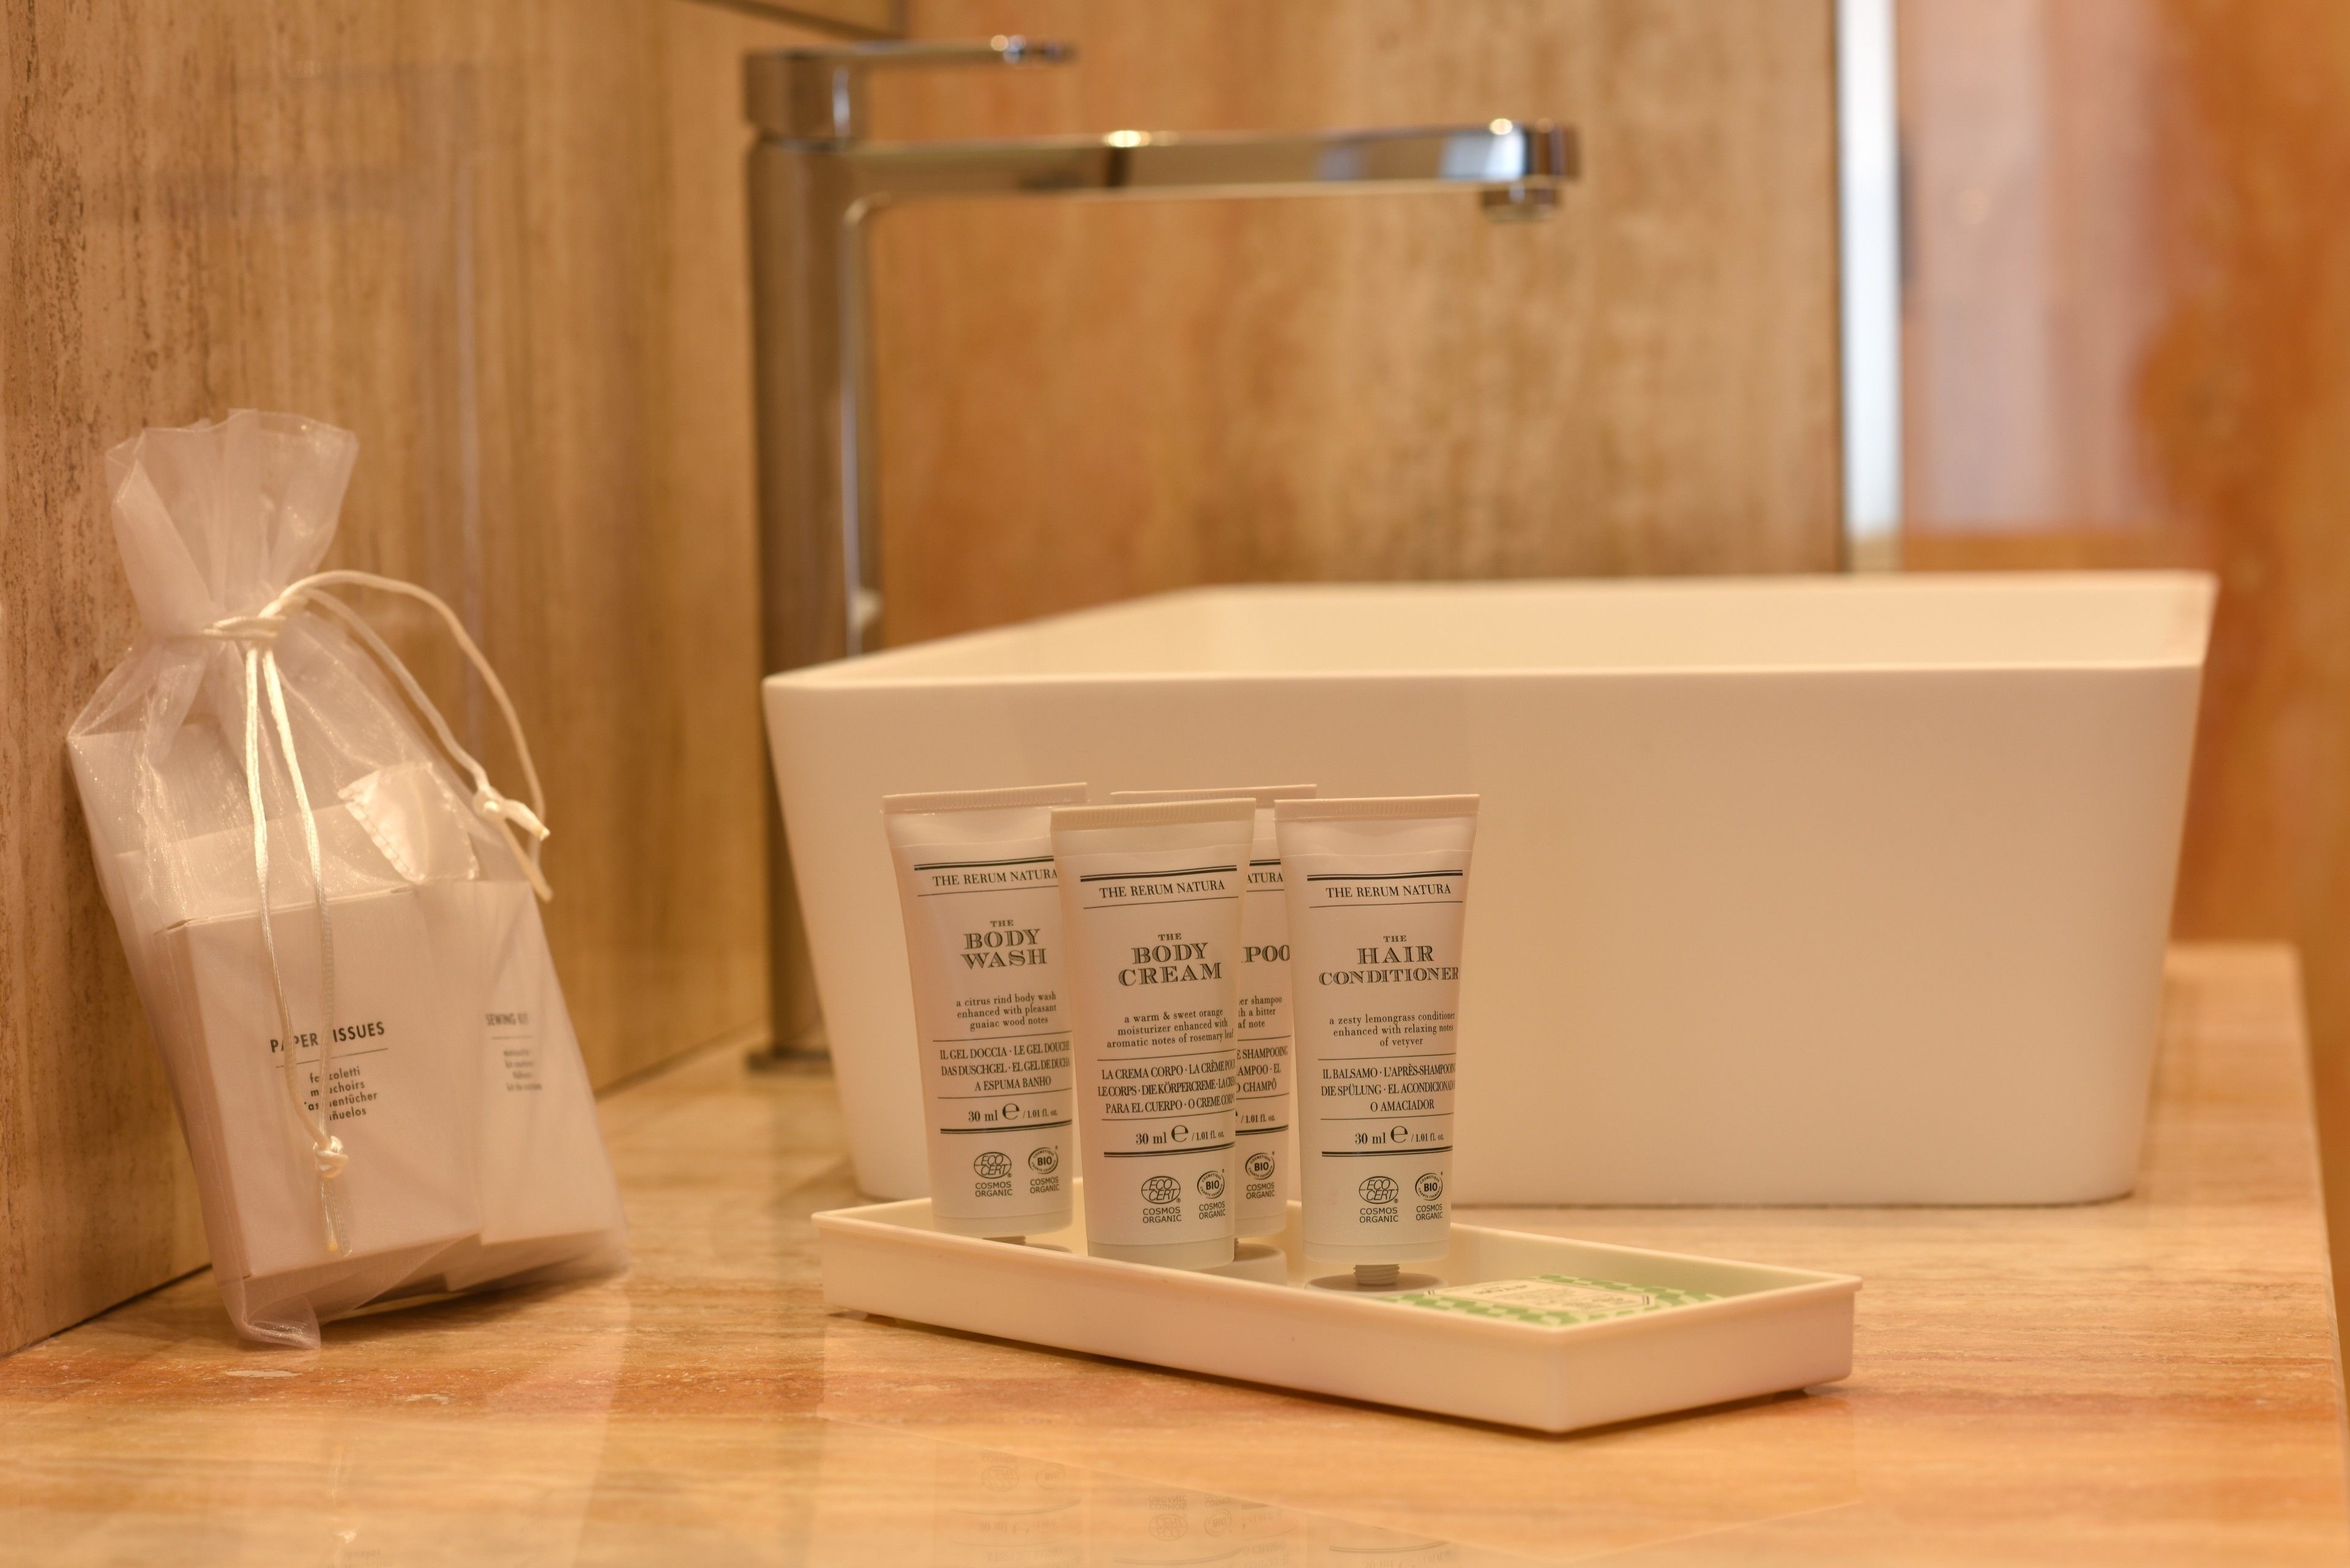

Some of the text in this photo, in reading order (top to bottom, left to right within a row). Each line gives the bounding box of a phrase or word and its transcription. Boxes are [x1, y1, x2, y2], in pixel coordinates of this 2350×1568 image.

[933, 869, 1058, 886] THE RERUM NATURA
[1247, 872, 1283, 884] ATURA
[1099, 880, 1225, 898] THE RERUM NATURA
[1326, 884, 1451, 898] THE RERUM NATURA
[963, 929, 1040, 949] BODY
[961, 949, 1047, 969] WASH
[1132, 943, 1209, 964] BODY
[1357, 946, 1434, 965] HAIR
[1119, 962, 1222, 987] CREAM
[1319, 966, 1459, 985] CONDITIONER
[965, 997, 990, 1006] citrus
[994, 993, 1012, 1004] rind
[1015, 993, 1035, 1009] body
[1038, 991, 1056, 1001] wash
[1251, 996, 1282, 1006] shampoo
[957, 1003, 1056, 1018] enhanced with pleasant
[1173, 1010, 1196, 1019] sweet
[1199, 1009, 1223, 1019] orange
[1256, 1007, 1276, 1016] bitter
[970, 1016, 1048, 1032] guaiac wood notes
[1338, 1017, 1361, 1026] zesty
[1365, 1014, 1415, 1026] lemongrass
[1418, 1011, 1455, 1021] conditioner
[334, 1021, 385, 1043] ISSUES
[1117, 1024, 1171, 1036] moisturizer
[1174, 1021, 1212, 1031] enhanced
[1214, 1018, 1228, 1028] with
[1334, 1026, 1378, 1036] enhanced
[1382, 1024, 1401, 1034] with
[1404, 1024, 1436, 1035] relaxing
[1106, 1029, 1234, 1048] aromatic notes of rosemary leaf
[1380, 1037, 1423, 1048] of vetyver
[940, 1040, 1070, 1059] IL GEL DOCCIA LE GEL DOUCHE
[941, 1066, 957, 1076] DAS
[958, 1064, 1007, 1075] DUSCHGEL
[1012, 1062, 1023, 1072] EL
[1024, 1061, 1040, 1070] GEL
[1041, 1059, 1051, 1069] DE
[1102, 1069, 1114, 1080] LA
[1115, 1067, 1149, 1079] CREMA
[1151, 1065, 1182, 1077] CORPO
[1189, 1064, 1199, 1074] LA
[1201, 1060, 1225, 1073] CRÈME
[1274, 1063, 1281, 1073] EL
[1322, 1069, 1332, 1080] IL
[1333, 1067, 1377, 1079] BALSAMO
[975, 1076, 1051, 1091] A ESPUMA BANHO
[1098, 1086, 1108, 1096] LE
[1108, 1085, 1137, 1096] CORPS
[1142, 1085, 1157, 1095] DIE
[1158, 1081, 1216, 1094] KÖRPERCREME
[1218, 1078, 1225, 1088] LA
[1243, 1080, 1277, 1092] CHAMPÔ
[1321, 1086, 1336, 1096] DIE
[1338, 1083, 1381, 1096] SPÜLUNG
[1388, 1084, 1399, 1094] EL
[1105, 1102, 1129, 1114] PARA
[1132, 1101, 1143, 1113] EL
[1145, 1099, 1182, 1112] CUERPO
[1188, 1099, 1195, 1108] O
[1196, 1096, 1220, 1108] CREME
[1370, 1099, 1434, 1112] O AMACIADOR
[968, 1111, 980, 1122] 30
[985, 1110, 998, 1121] ml
[1136, 1133, 1148, 1144] 30
[1153, 1132, 1167, 1143] ml
[1355, 1133, 1367, 1144] 30
[1372, 1133, 1386, 1144] ml
[981, 1155, 1003, 1165] ECO
[1037, 1157, 1052, 1166] BIO
[980, 1165, 1006, 1176] CERT
[1255, 1162, 1269, 1171] BIO
[1030, 1176, 1059, 1186] COSMOS
[1149, 1179, 1172, 1190] ECO
[1206, 1181, 1219, 1190] BIO
[1247, 1182, 1274, 1192] COSMOS
[1367, 1179, 1390, 1190] ECO
[1030, 1184, 1059, 1193] ORGANIC
[1424, 1183, 1437, 1192] BIO
[1149, 1189, 1176, 1201] CERT
[1246, 1190, 1275, 1200] ORGANIC
[1366, 1190, 1393, 1201] CERT
[1143, 1207, 1180, 1215] COSMOS
[1199, 1201, 1225, 1211] COSMOS
[1417, 1204, 1442, 1213] COSMOS
[1143, 1215, 1181, 1223] ORGANIC
[1199, 1209, 1226, 1220] ORGANIC
[1359, 1215, 1398, 1223] ORGANIC
[1416, 1212, 1442, 1221] ORGANIC
